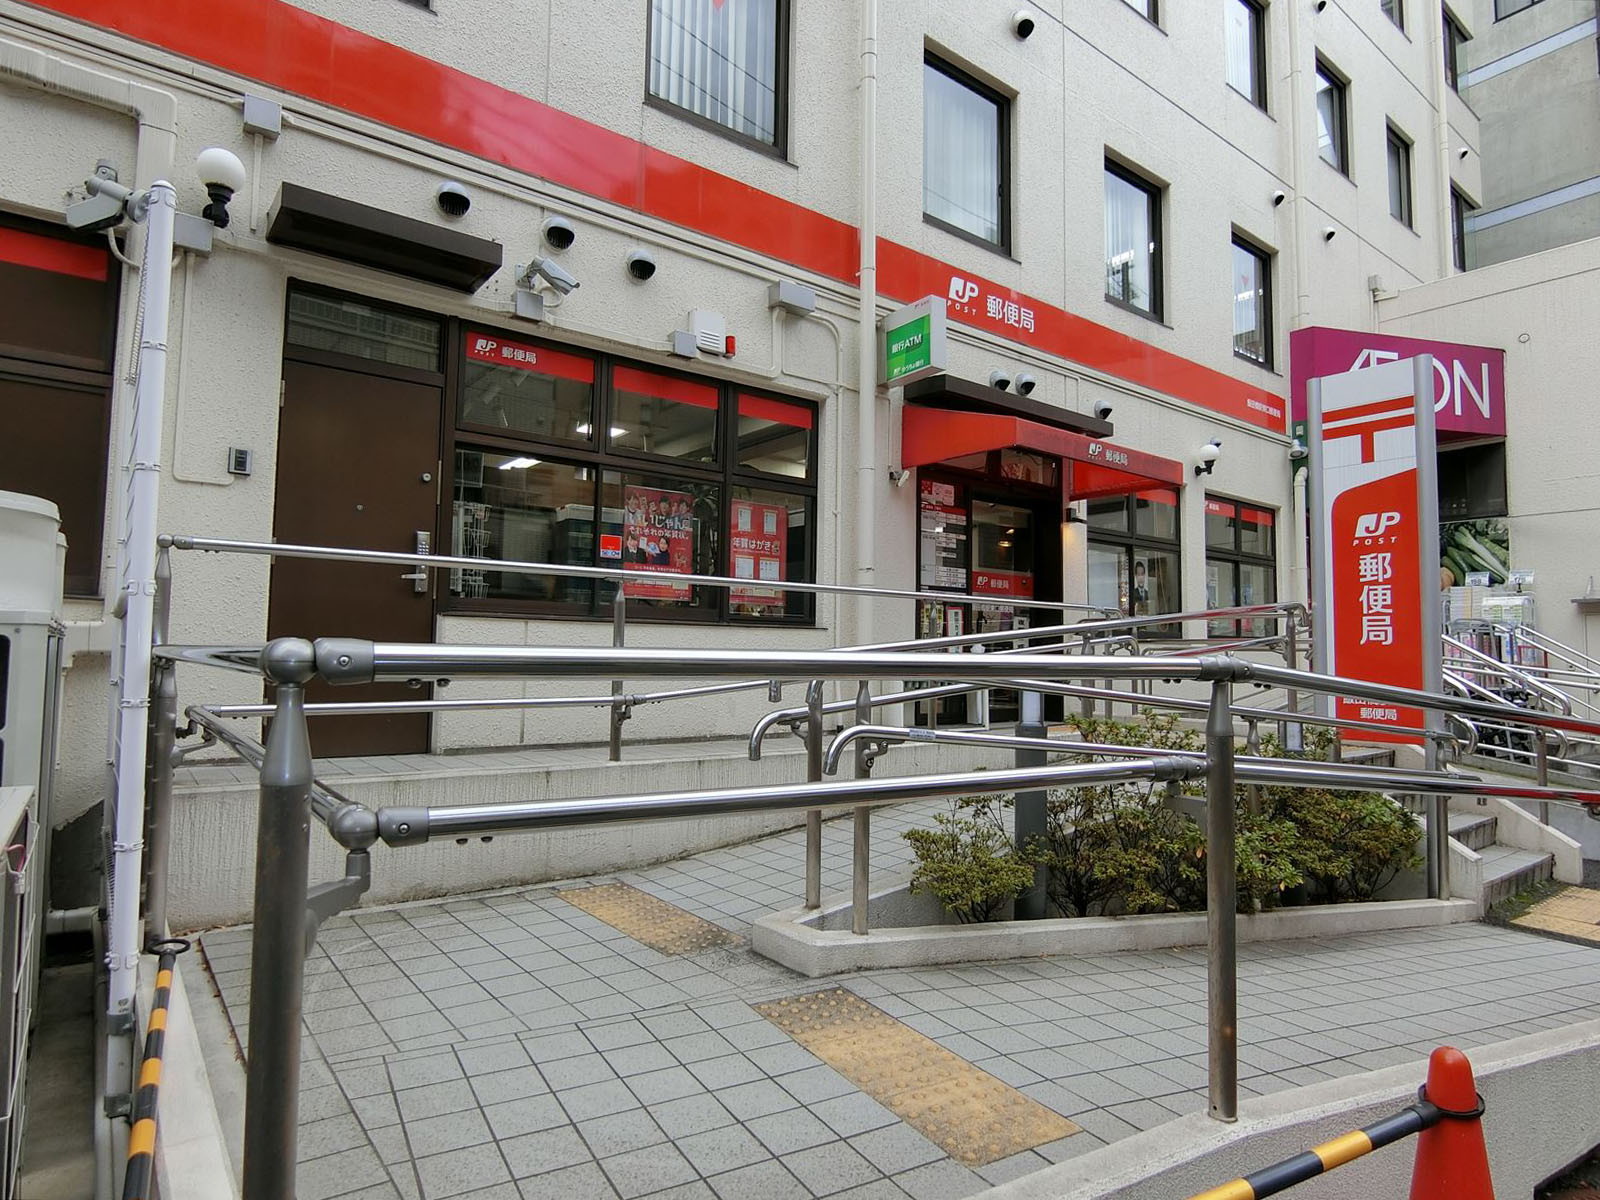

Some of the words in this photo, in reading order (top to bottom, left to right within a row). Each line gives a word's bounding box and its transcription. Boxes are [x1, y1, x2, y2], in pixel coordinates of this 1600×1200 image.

[947, 300, 977, 316] POST
[987, 295, 1034, 333] 郵便局
[892, 333, 922, 354] 銀行ATM
[501, 346, 537, 365] 郵便局
[1105, 449, 1128, 466] 郵便局
[732, 536, 772, 551] 年賀はがき
[1353, 536, 1398, 547] POST
[1358, 552, 1393, 646] 郵便局
[1360, 707, 1397, 721] 郵便局
